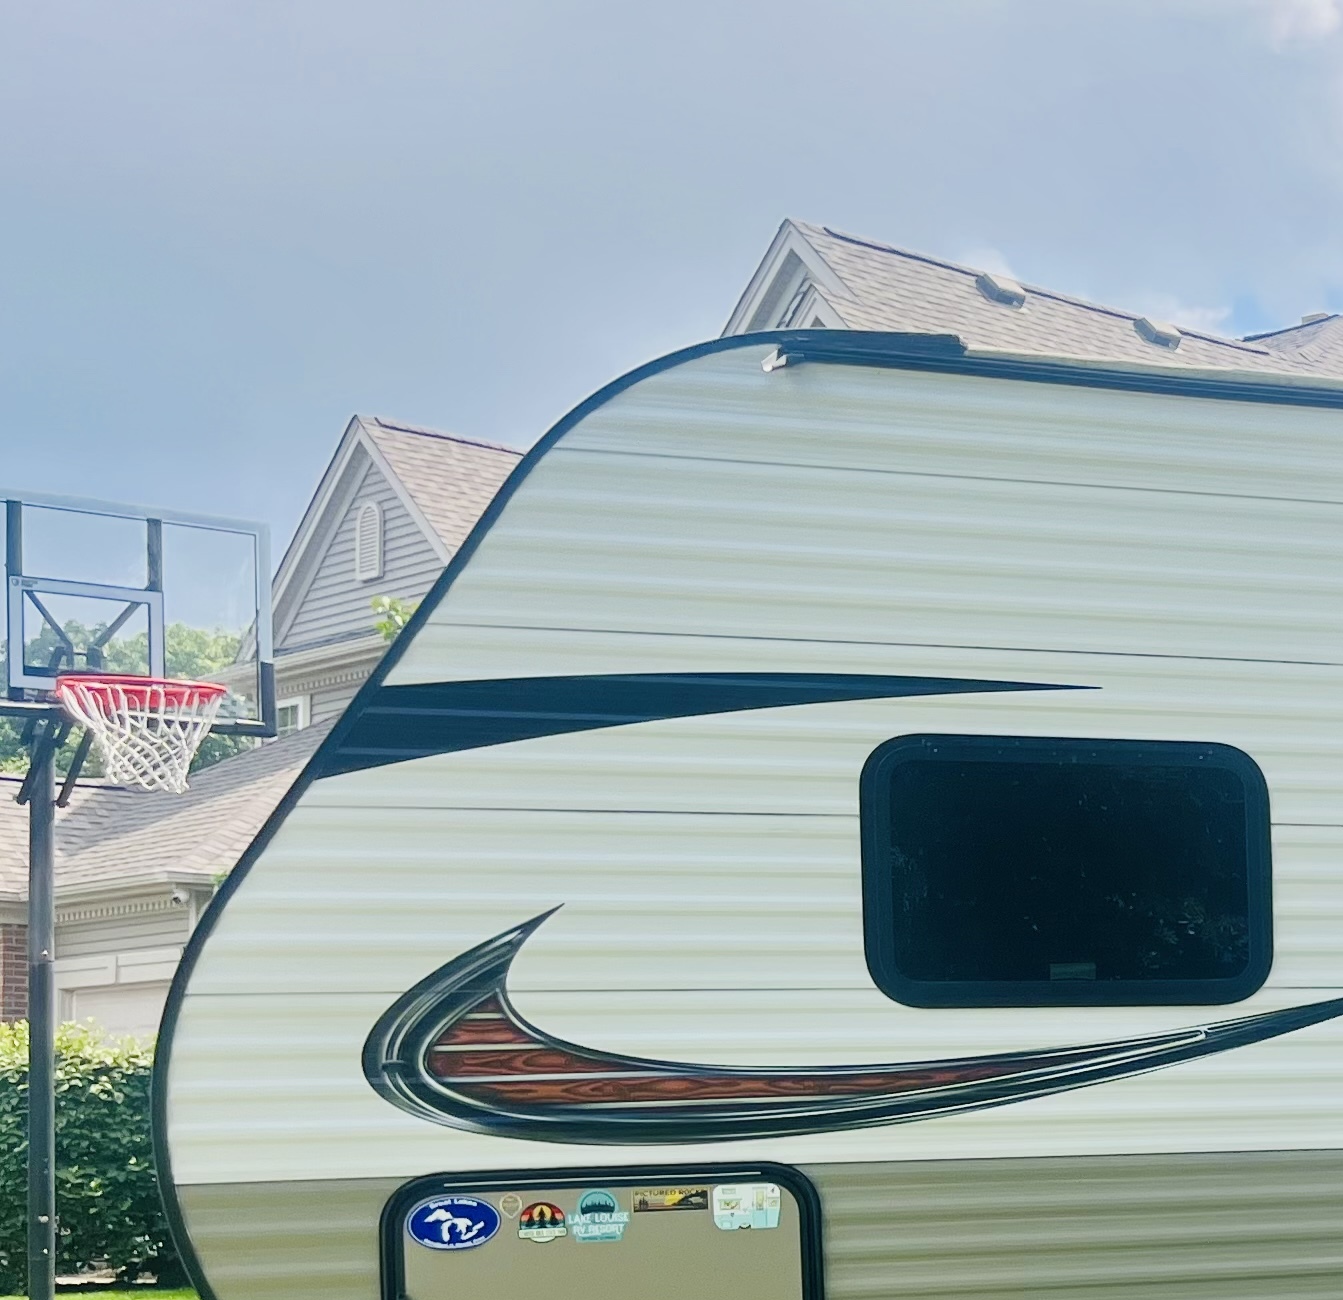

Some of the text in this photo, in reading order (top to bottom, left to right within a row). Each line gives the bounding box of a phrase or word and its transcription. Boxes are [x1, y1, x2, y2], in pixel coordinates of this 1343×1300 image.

[634, 1189, 677, 1197] PICTURED
[568, 1211, 630, 1225] LAKE LOUISE
